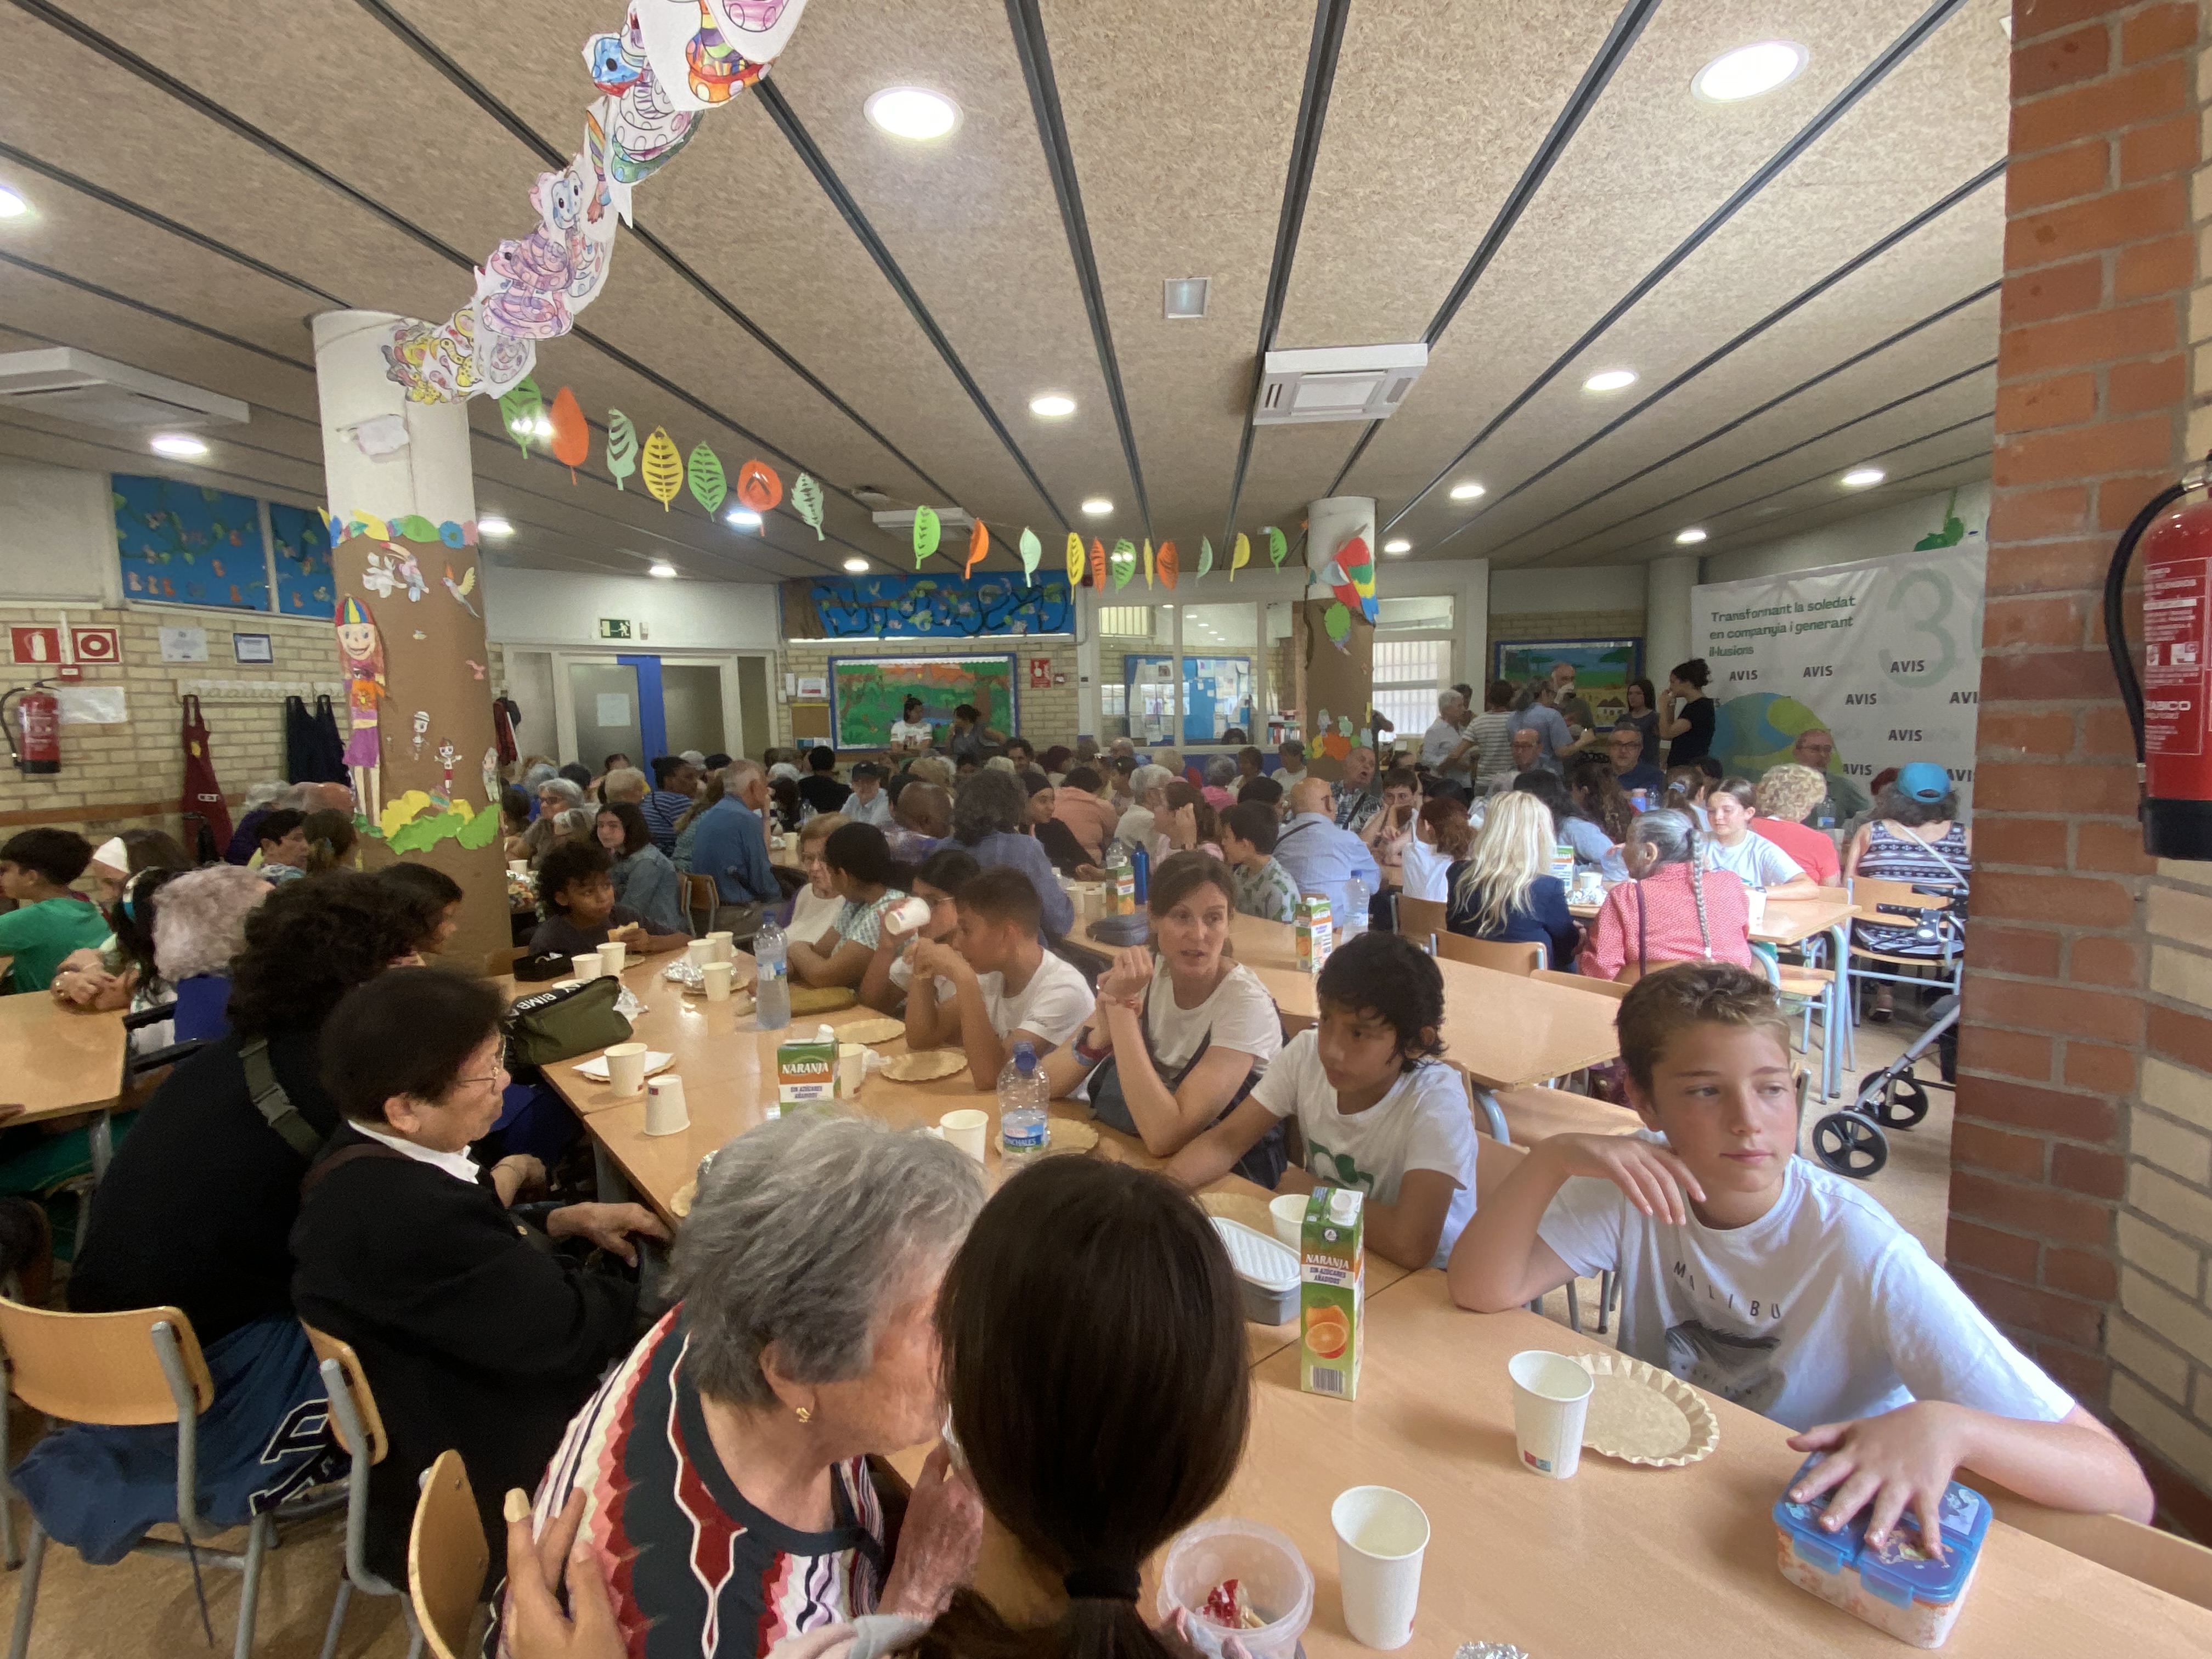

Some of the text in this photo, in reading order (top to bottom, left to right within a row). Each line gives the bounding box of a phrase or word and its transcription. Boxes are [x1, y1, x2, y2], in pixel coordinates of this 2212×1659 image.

[1711, 596, 1856, 622] Transformant la soledat
[1709, 616, 1853, 640] en companyia i generant
[1803, 665, 1833, 678] AVIS
[1890, 660, 1925, 673] AVIS
[1729, 670, 1758, 681] AVIS
[1845, 693, 1877, 706] AVIS
[1949, 691, 1978, 703] AVI
[1888, 730, 1923, 742] AVIS
[782, 1062, 828, 1075] NARANJA
[1306, 1254, 1349, 1269] NARANJA
[1674, 1261, 1781, 1319] MALIBU
